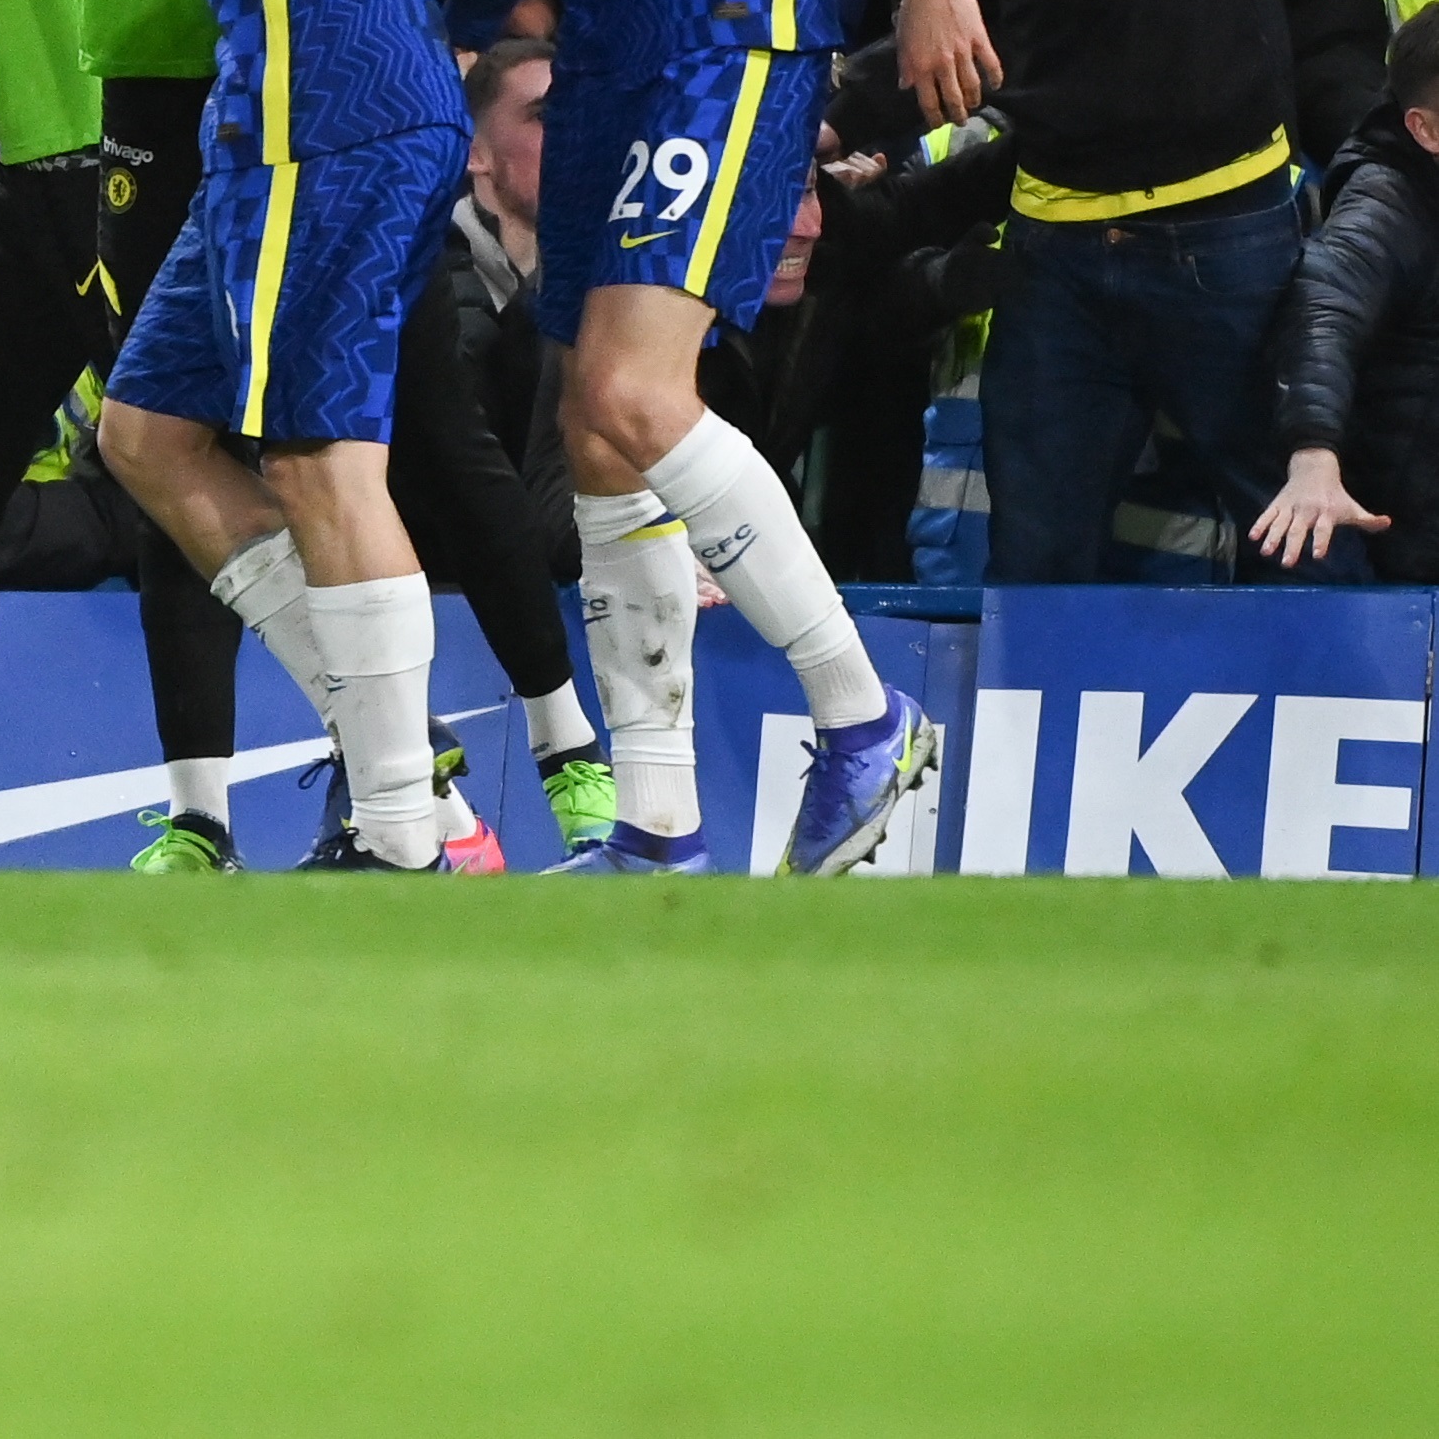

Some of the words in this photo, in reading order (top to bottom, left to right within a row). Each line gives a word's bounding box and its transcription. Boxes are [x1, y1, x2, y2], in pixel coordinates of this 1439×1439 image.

[103, 135, 154, 166] trivago
[608, 137, 709, 222] 29
[701, 523, 753, 559] CFC
